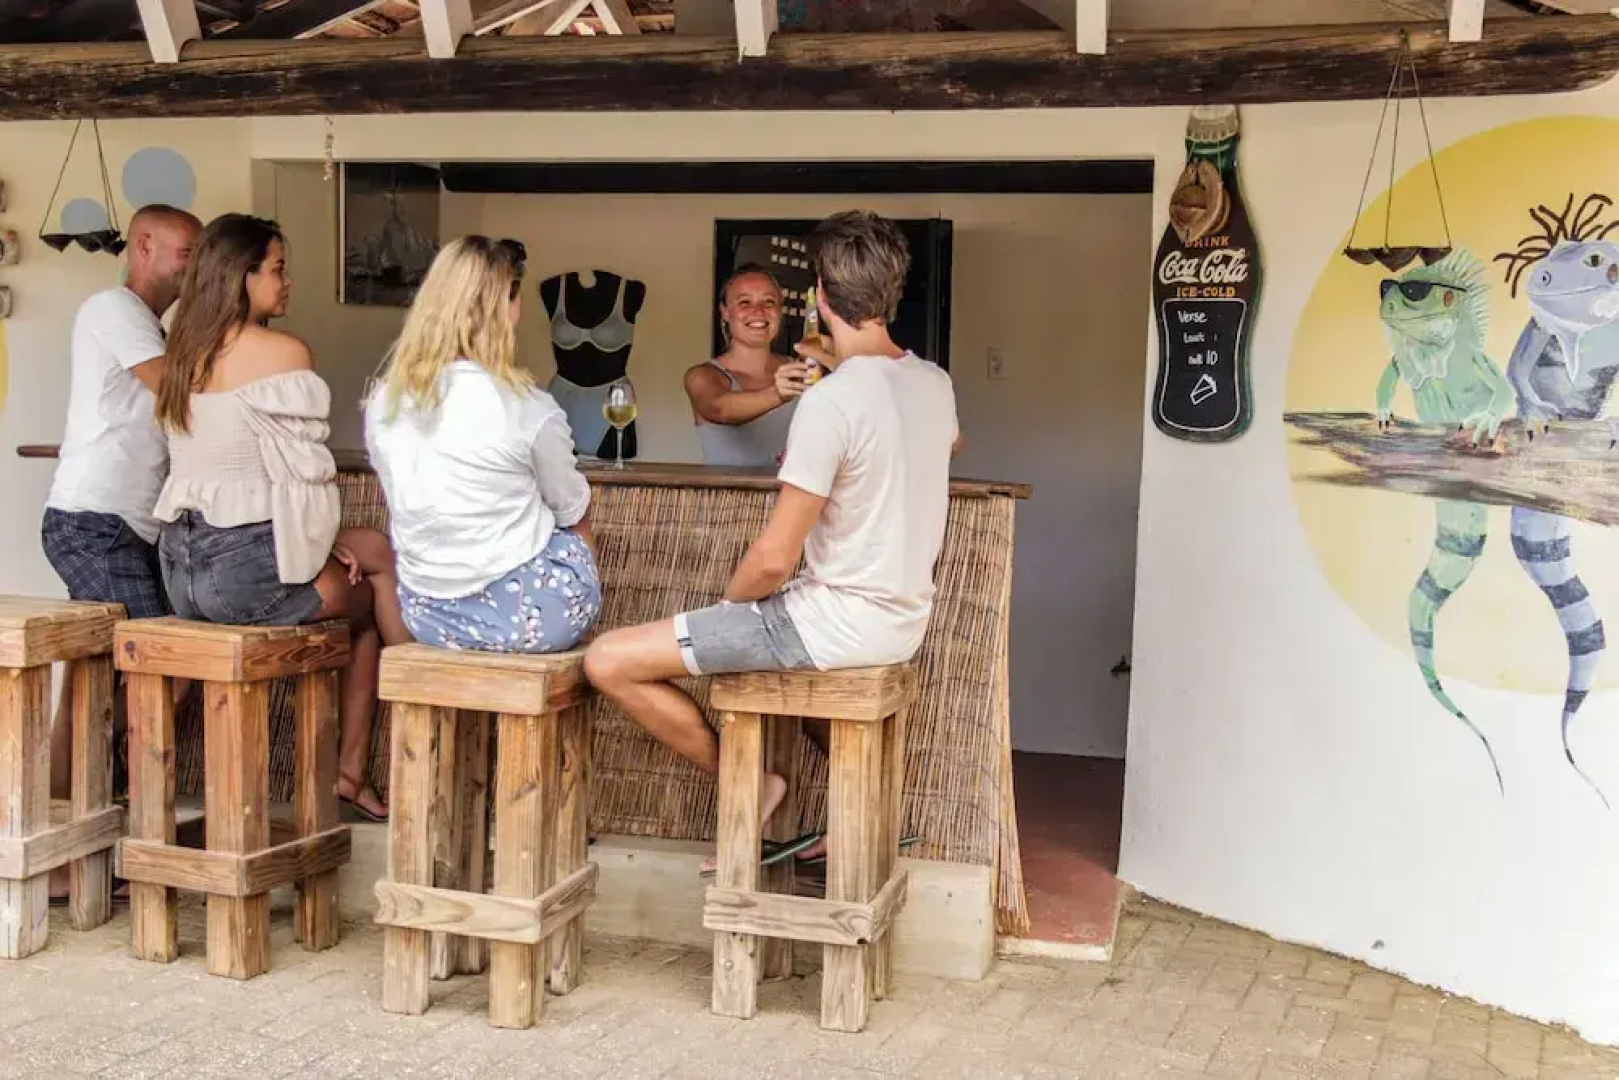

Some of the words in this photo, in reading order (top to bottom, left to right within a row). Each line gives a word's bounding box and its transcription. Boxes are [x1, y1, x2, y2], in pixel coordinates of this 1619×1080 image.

[1159, 250, 1199, 284] Coca
[1199, 248, 1248, 284] Cola
[1176, 286, 1236, 298] ICE-COLD
[1177, 310, 1208, 323] Verse
